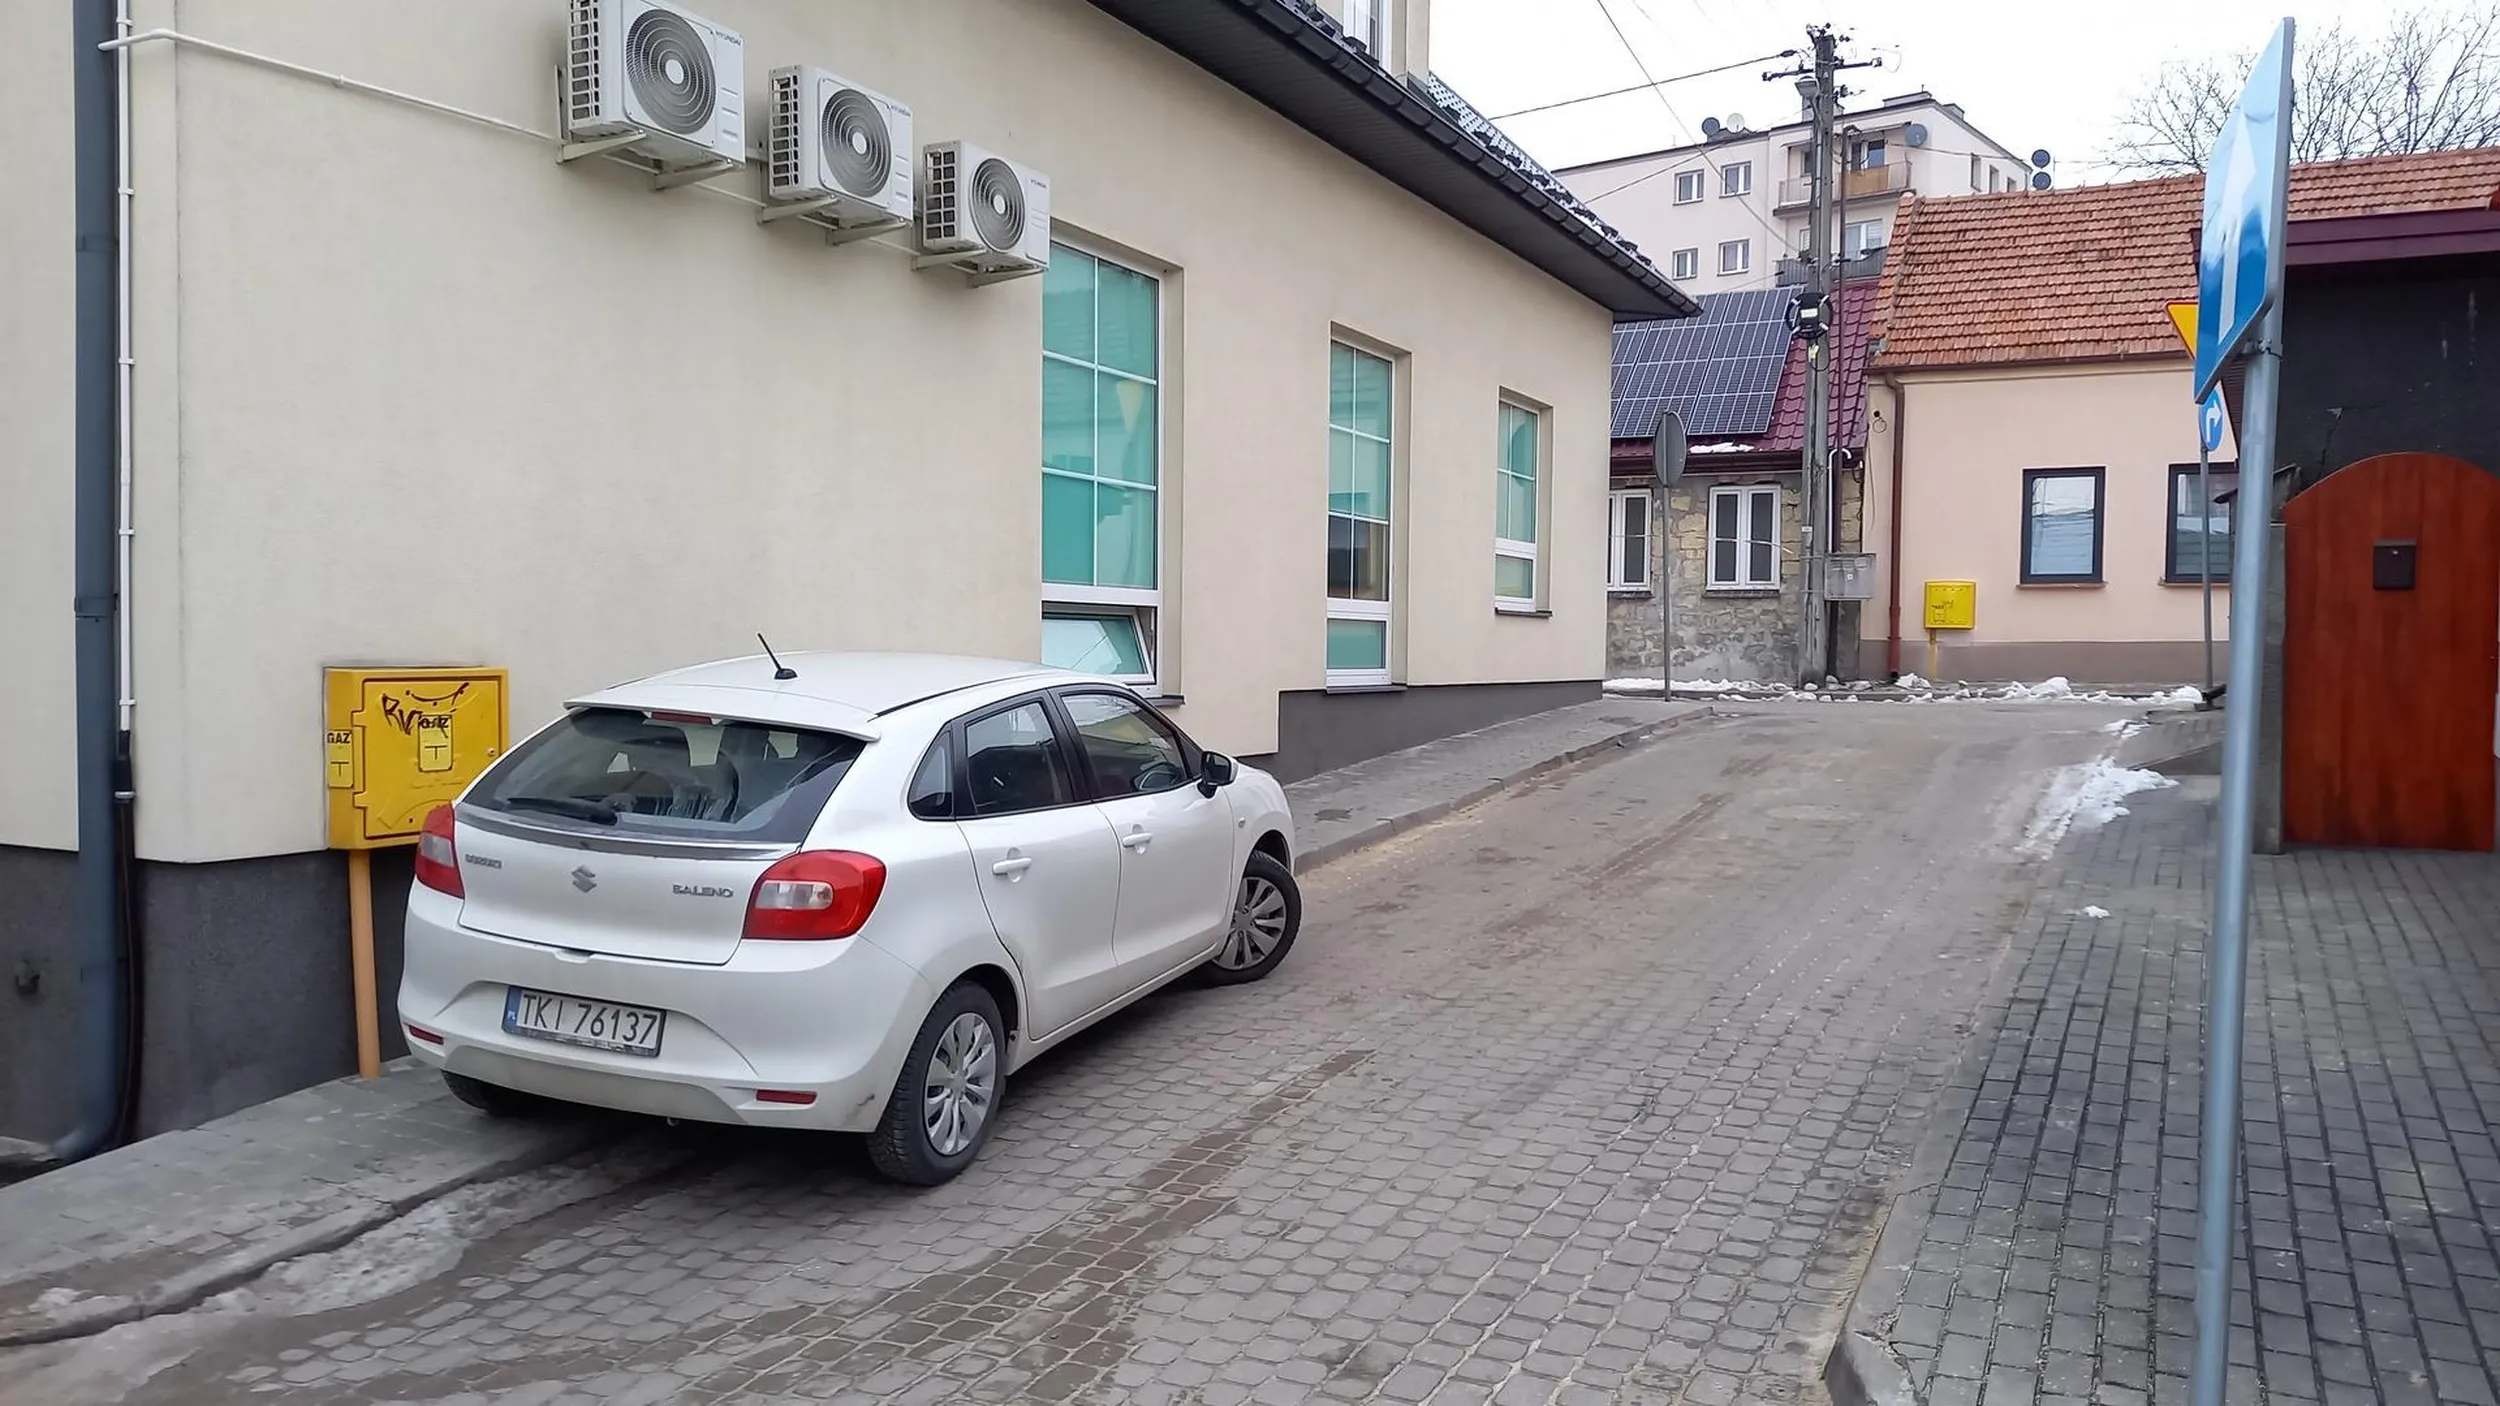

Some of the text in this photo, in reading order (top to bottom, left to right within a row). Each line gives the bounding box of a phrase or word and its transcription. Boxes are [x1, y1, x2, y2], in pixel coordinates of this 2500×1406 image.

[327, 732, 351, 744] GAZ
[672, 884, 734, 898] BALENO
[523, 994, 563, 1031] TKI
[573, 1003, 658, 1045] 76137
